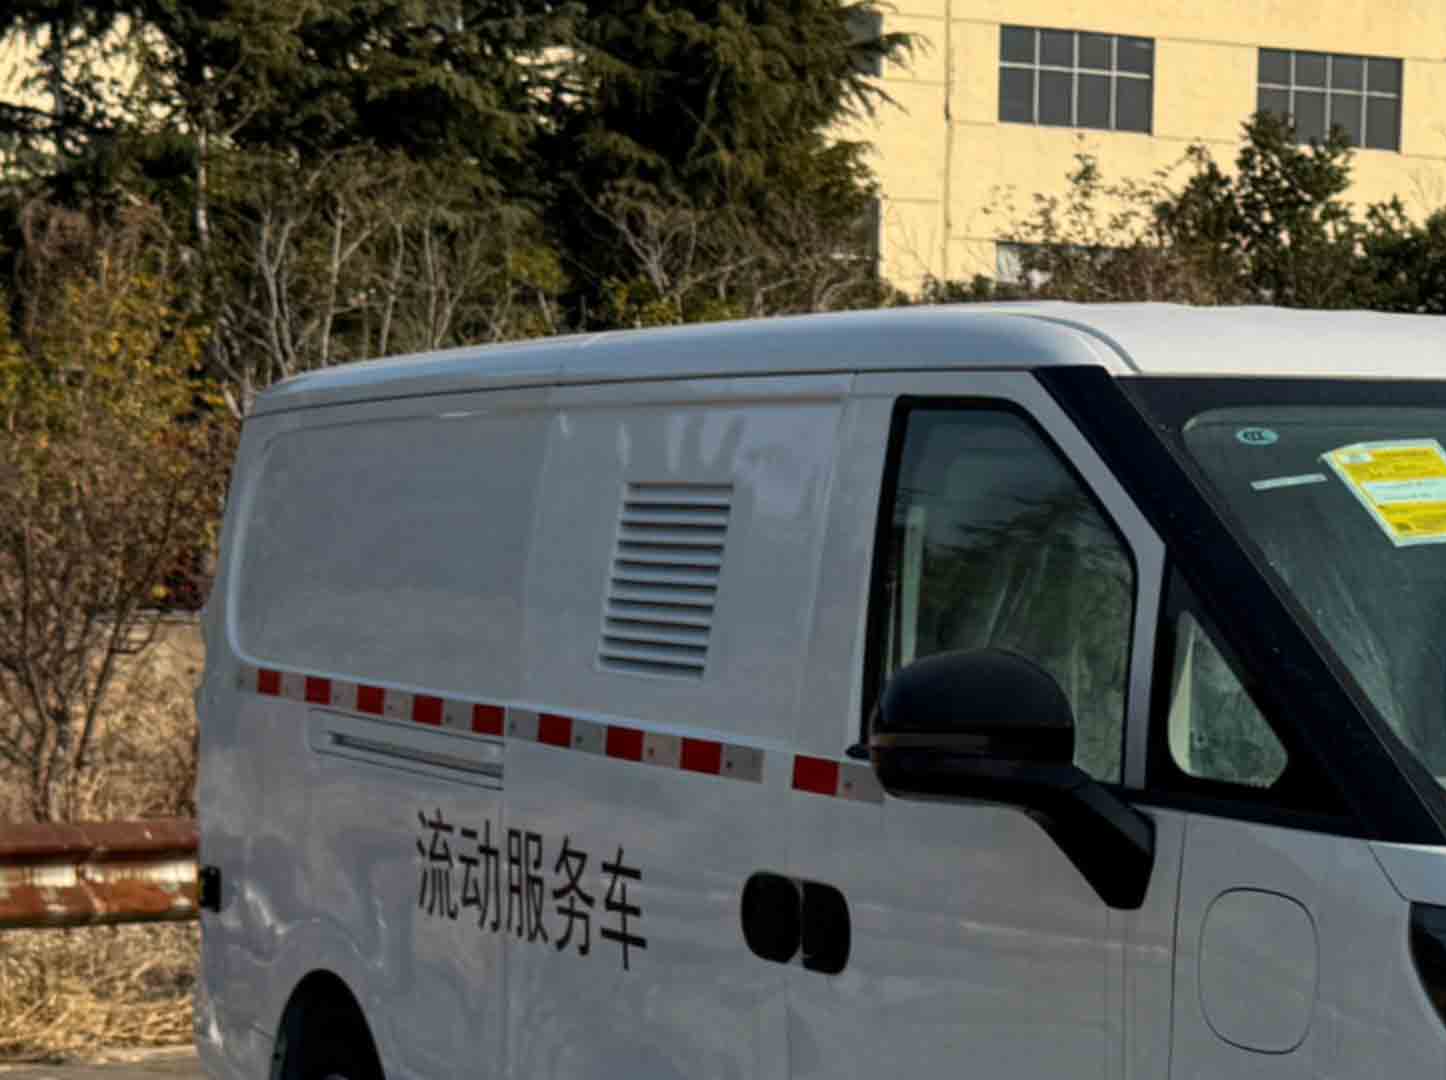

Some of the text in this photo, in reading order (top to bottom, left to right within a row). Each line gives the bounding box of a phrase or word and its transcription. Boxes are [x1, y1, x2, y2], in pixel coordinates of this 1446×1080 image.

[416, 808, 647, 971] 流动服务车
